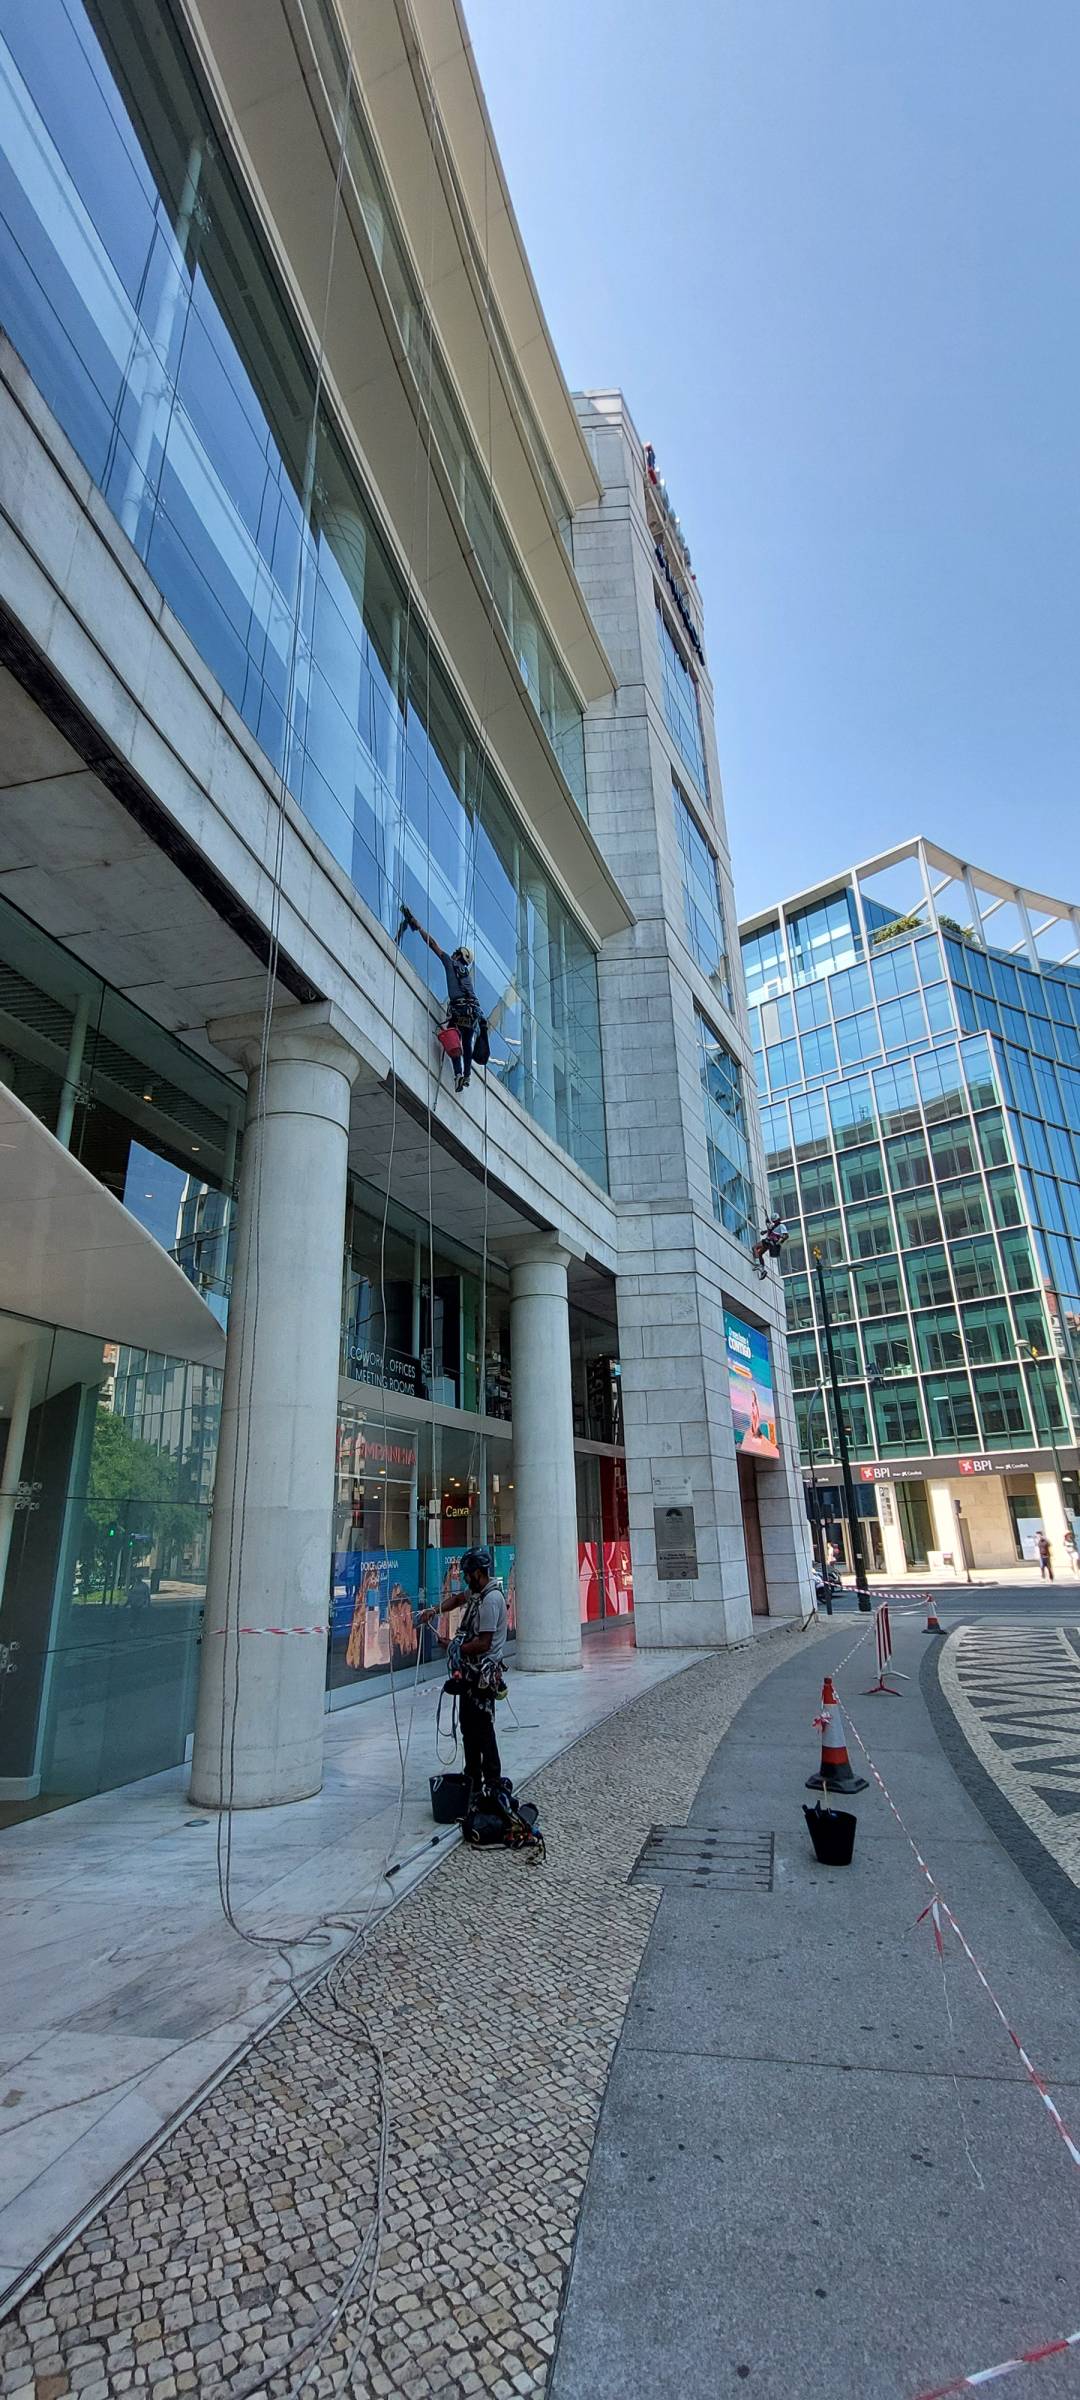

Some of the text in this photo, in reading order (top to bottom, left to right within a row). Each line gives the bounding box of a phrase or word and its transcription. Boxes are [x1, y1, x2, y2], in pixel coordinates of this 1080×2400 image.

[389, 1359, 416, 1378] OFFICES
[355, 1367, 415, 1396] MEETING ROOMS
[973, 1460, 993, 1471] BPI
[873, 1467, 891, 1478] BPI
[446, 1505, 470, 1518] Caixa
